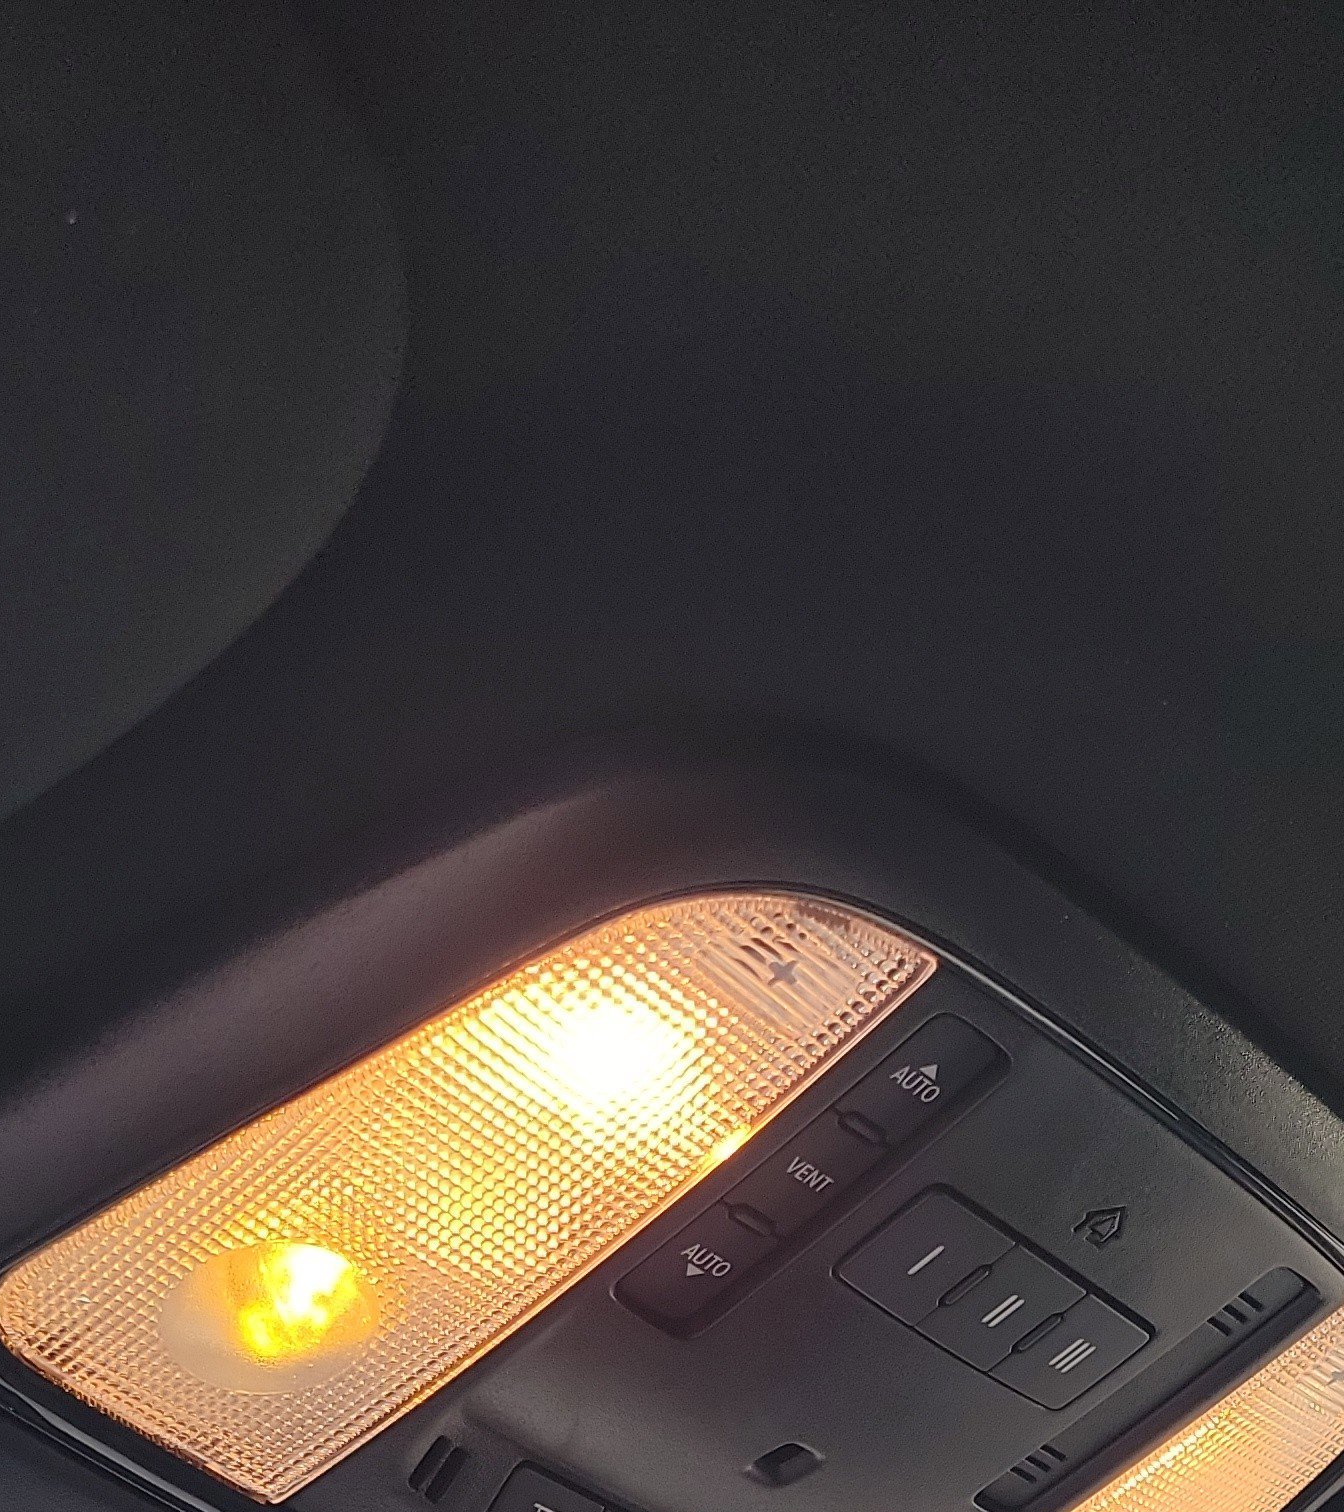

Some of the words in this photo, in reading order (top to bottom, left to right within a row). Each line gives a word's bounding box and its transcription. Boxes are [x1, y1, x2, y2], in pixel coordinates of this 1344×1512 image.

[890, 1064, 941, 1104] AUTO
[787, 1156, 834, 1193] VENT
[680, 1243, 730, 1278] AUTO
